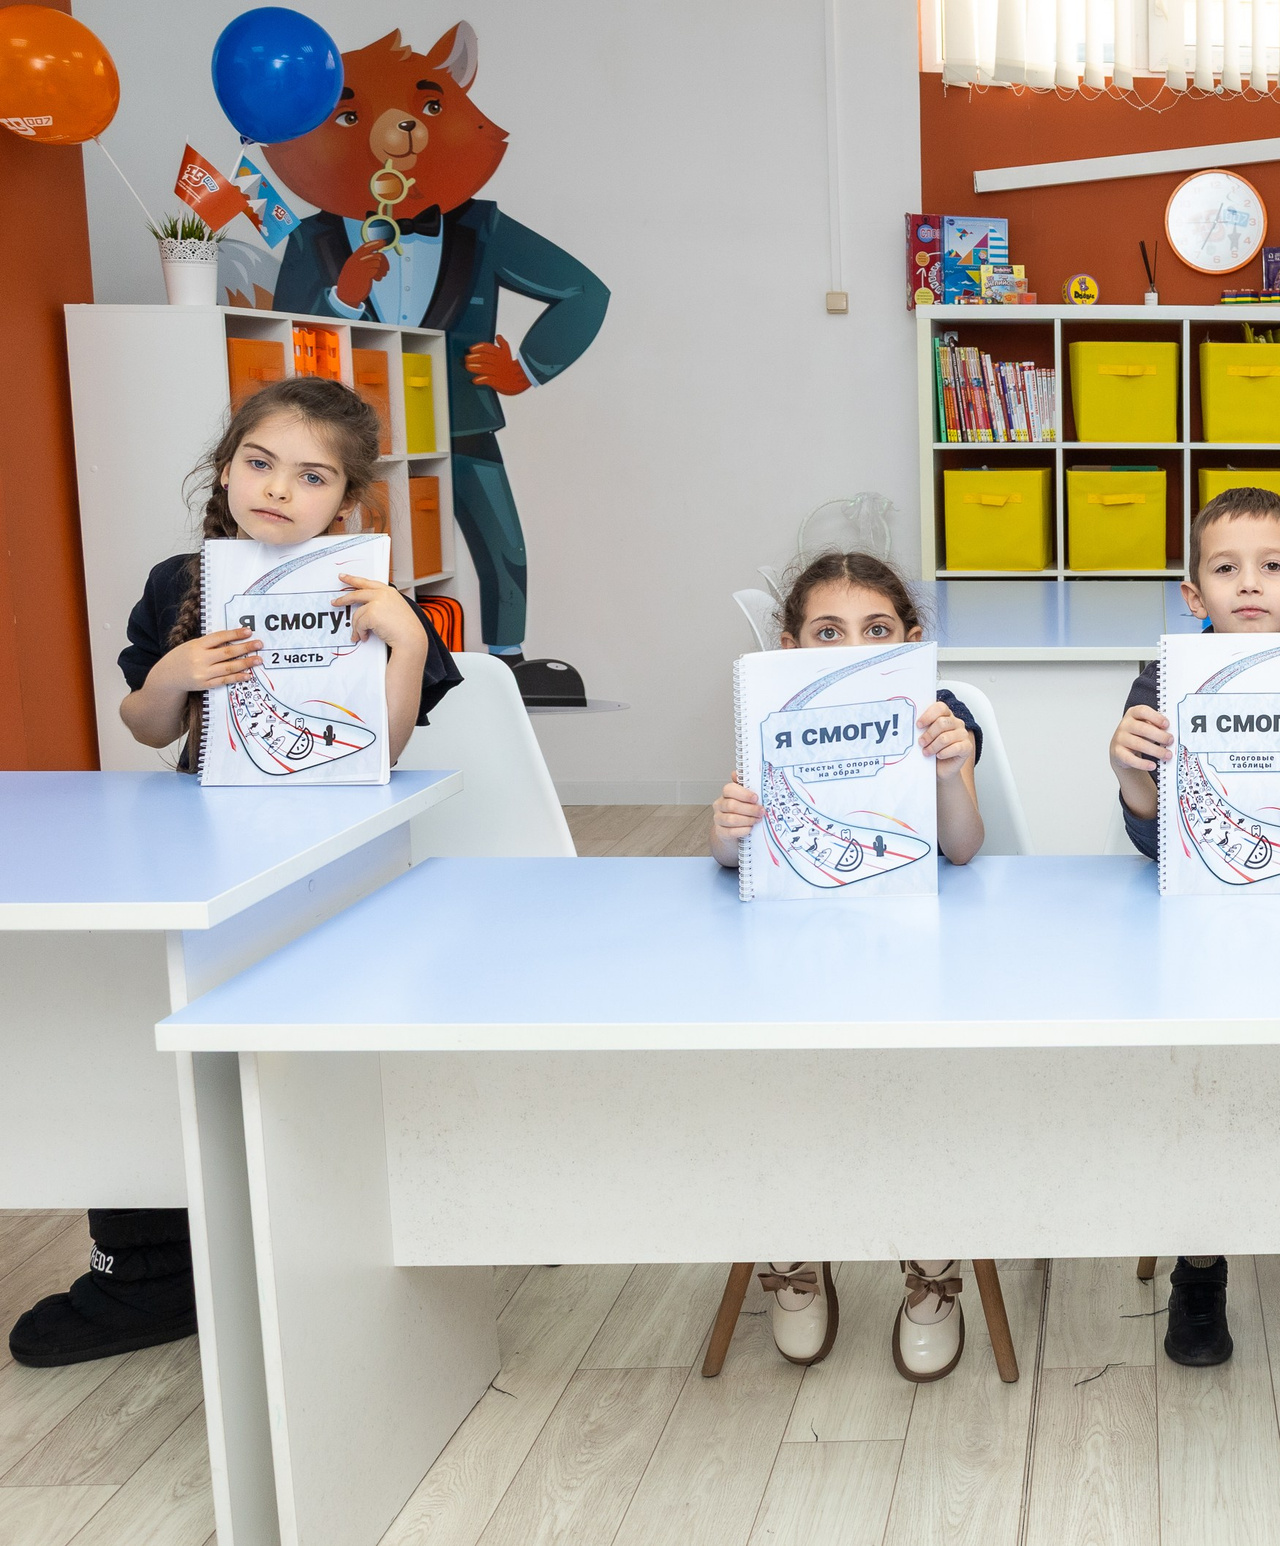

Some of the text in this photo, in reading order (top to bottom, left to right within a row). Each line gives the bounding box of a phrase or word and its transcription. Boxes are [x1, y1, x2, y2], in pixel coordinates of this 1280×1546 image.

[25, 117, 51, 126] 007
[1243, 199, 1251, 208] 2
[1248, 218, 1257, 226] 3
[1243, 236, 1251, 245] 4
[1231, 250, 1239, 259] 5
[1213, 255, 1221, 264] 6
[239, 604, 352, 635] я смогу!
[271, 652, 324, 664] 2 часть
[1190, 714, 1207, 733] я
[775, 713, 899, 749] я смогу!
[1229, 754, 1275, 762] Слоговые
[798, 762, 835, 773] Тексты
[847, 757, 880, 768] опорой
[1232, 761, 1272, 769] таблицы
[833, 768, 860, 777] образ
